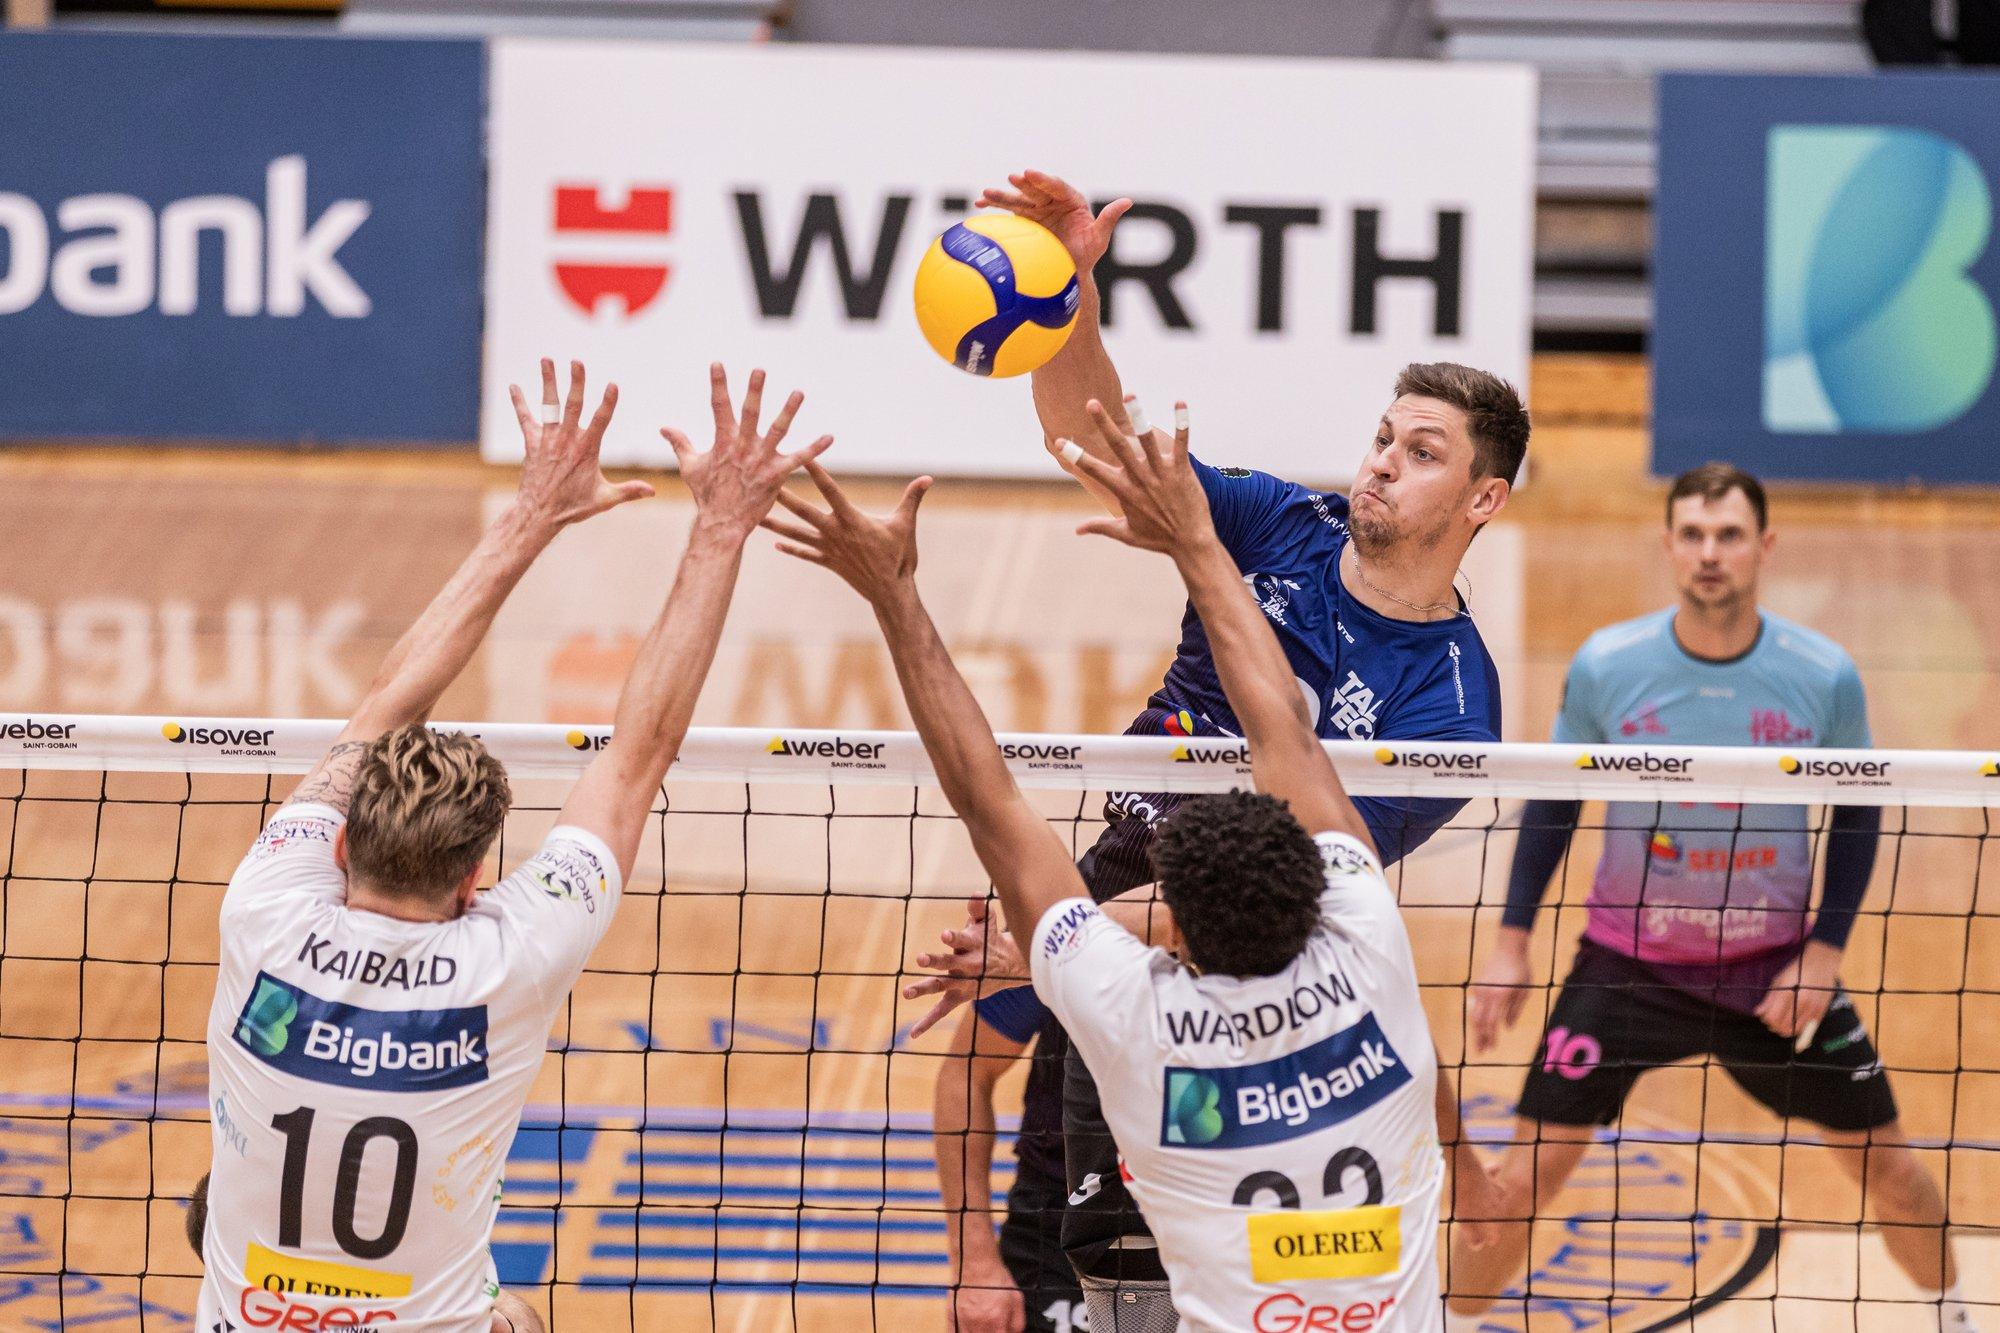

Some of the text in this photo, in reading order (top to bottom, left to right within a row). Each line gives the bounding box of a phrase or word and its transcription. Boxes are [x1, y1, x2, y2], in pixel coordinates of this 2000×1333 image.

[734, 191, 1465, 337] WRTH
[1330, 687, 1375, 740] TEC
[792, 736, 886, 760] weber
[831, 761, 887, 769] SAINT-GOBAIN
[1028, 762, 1083, 770] SAINT-GOBAIN
[1199, 744, 1253, 764] web
[1599, 752, 1693, 773] weber
[298, 932, 458, 991] KAIBALD
[1166, 971, 1357, 1047] WARDLOW
[304, 1020, 482, 1077] Bigbank
[1543, 1026, 1602, 1080] 10
[1236, 1039, 1397, 1127] Bigbank
[271, 1105, 419, 1261] 10
[1274, 1230, 1384, 1259] OLEREX
